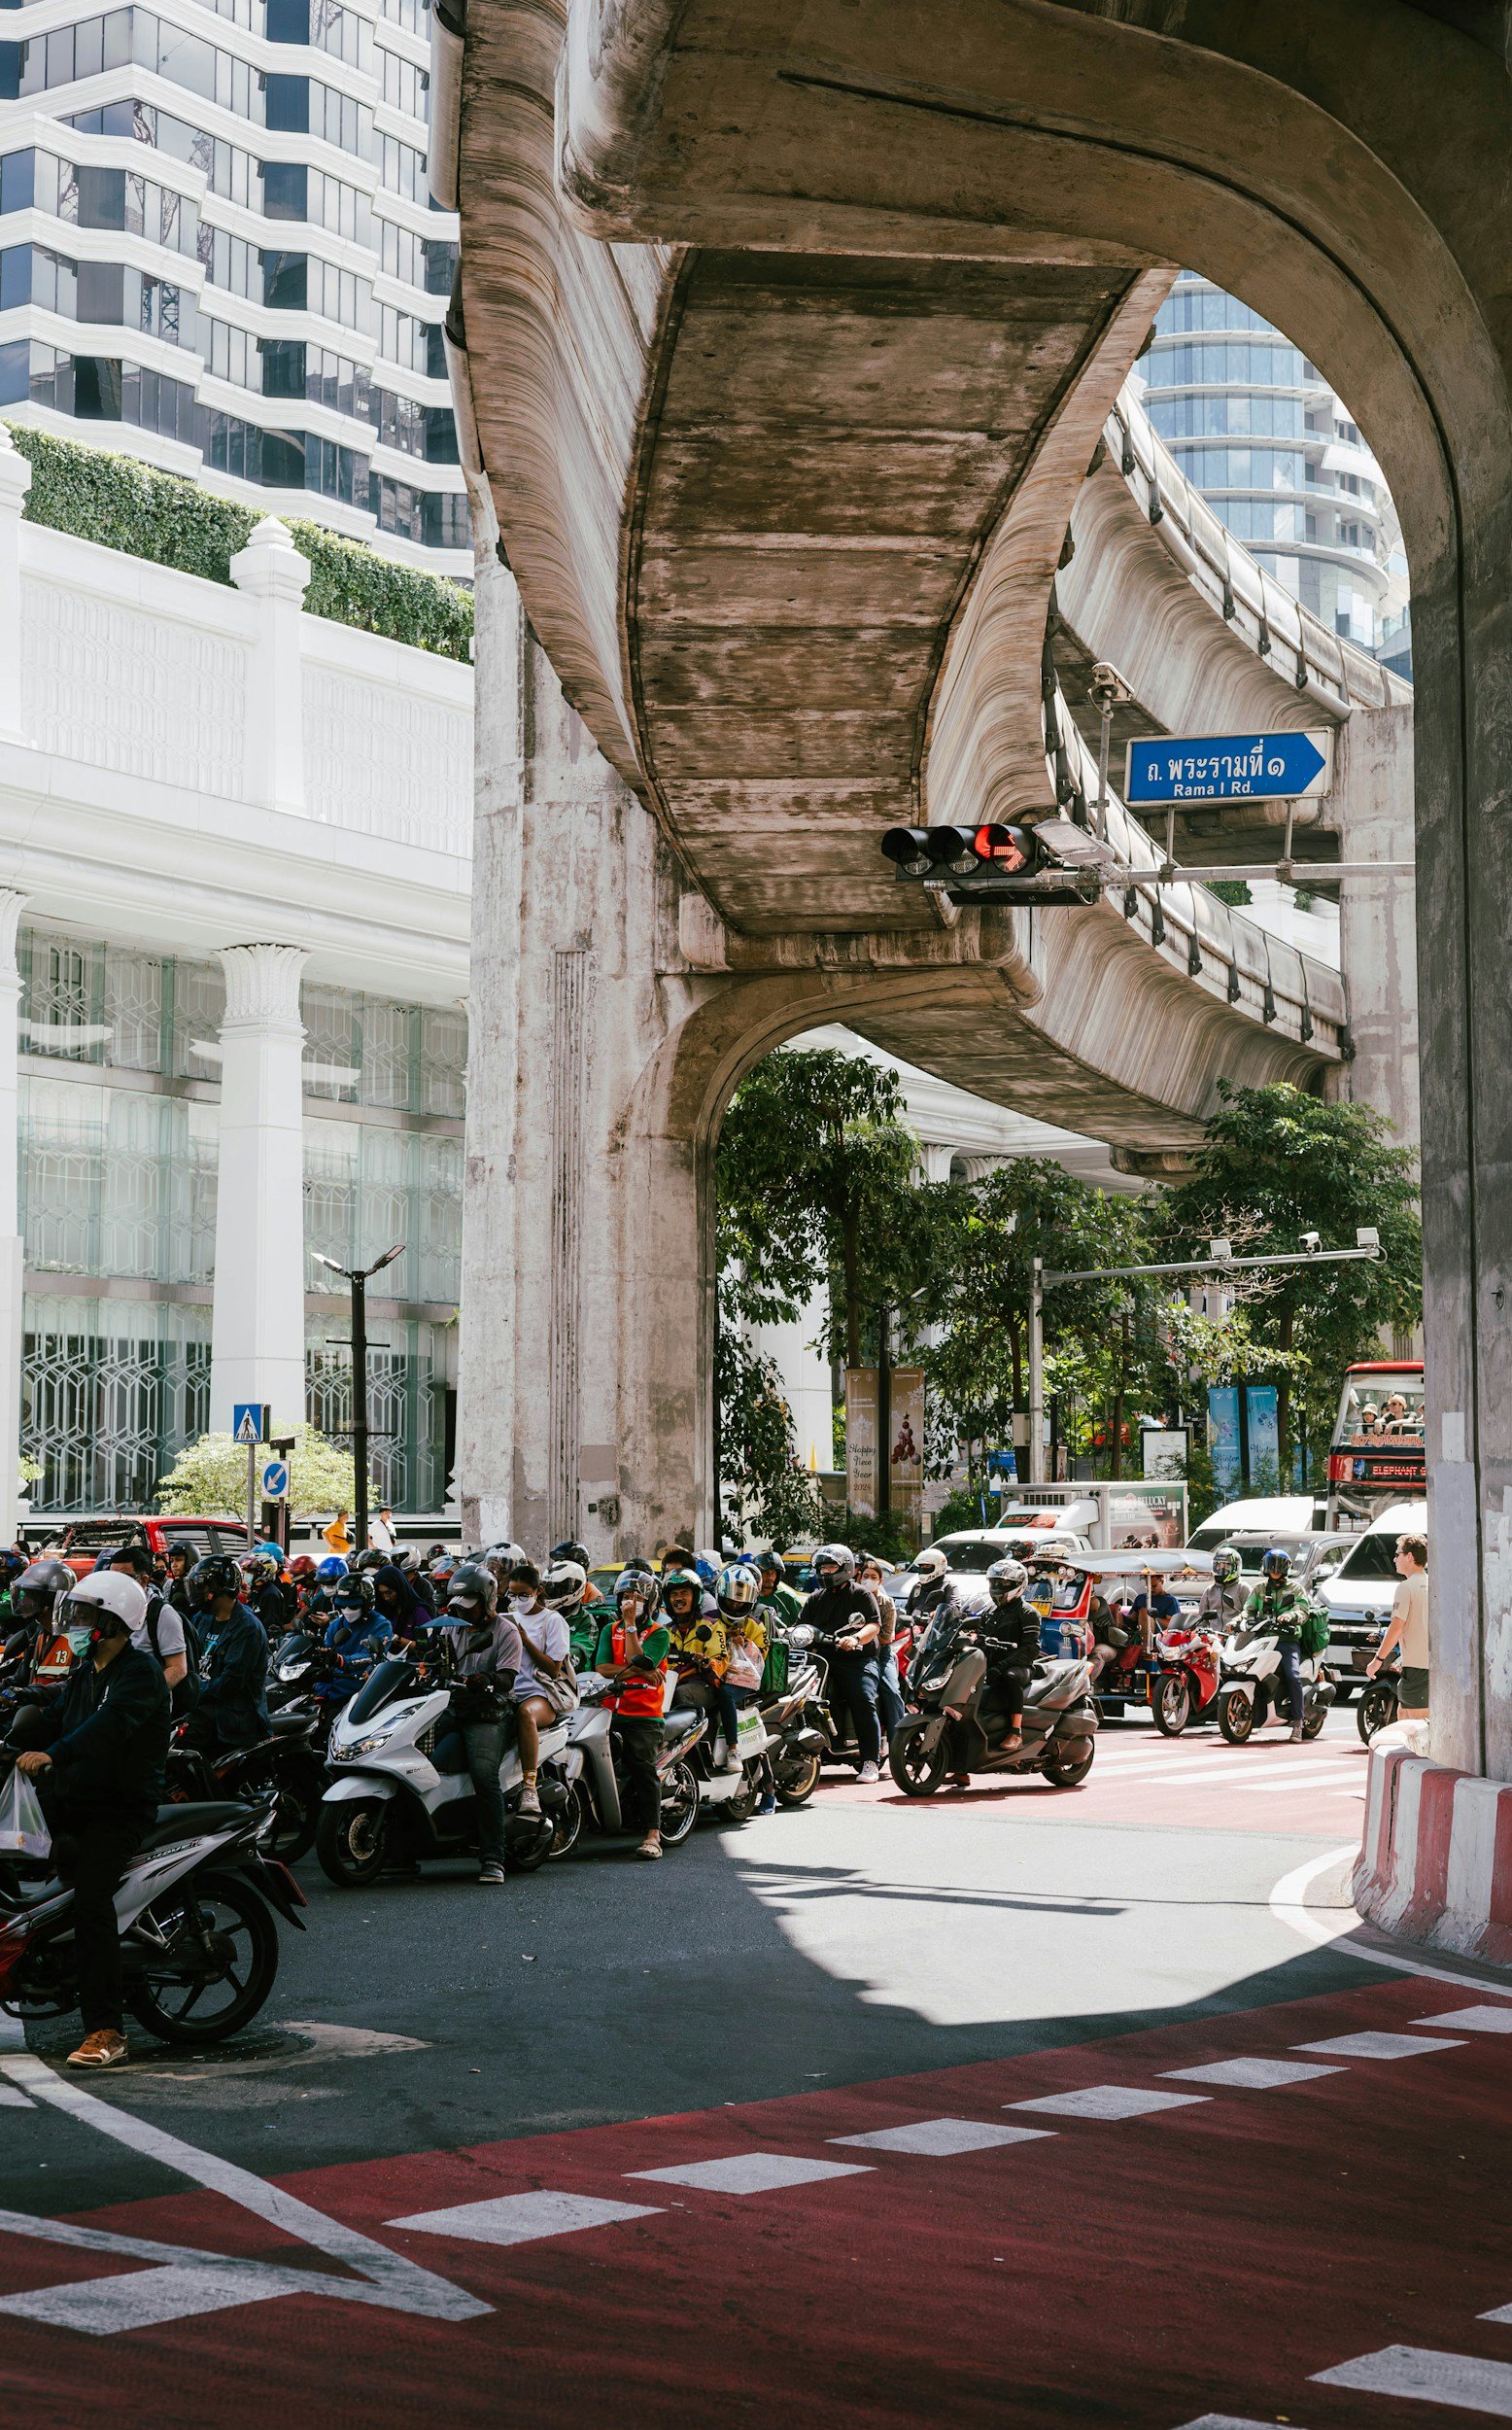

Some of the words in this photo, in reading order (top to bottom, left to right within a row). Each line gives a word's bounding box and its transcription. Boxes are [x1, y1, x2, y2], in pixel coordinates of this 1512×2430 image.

[1174, 783, 1215, 797] Rama
[1231, 781, 1254, 795] Rd.
[848, 1443, 876, 1456] Happy
[853, 1456, 873, 1466] New
[853, 1468, 873, 1478] Year
[1372, 1466, 1418, 1475] ELEPHANT
[55, 1650, 68, 1664] 13
